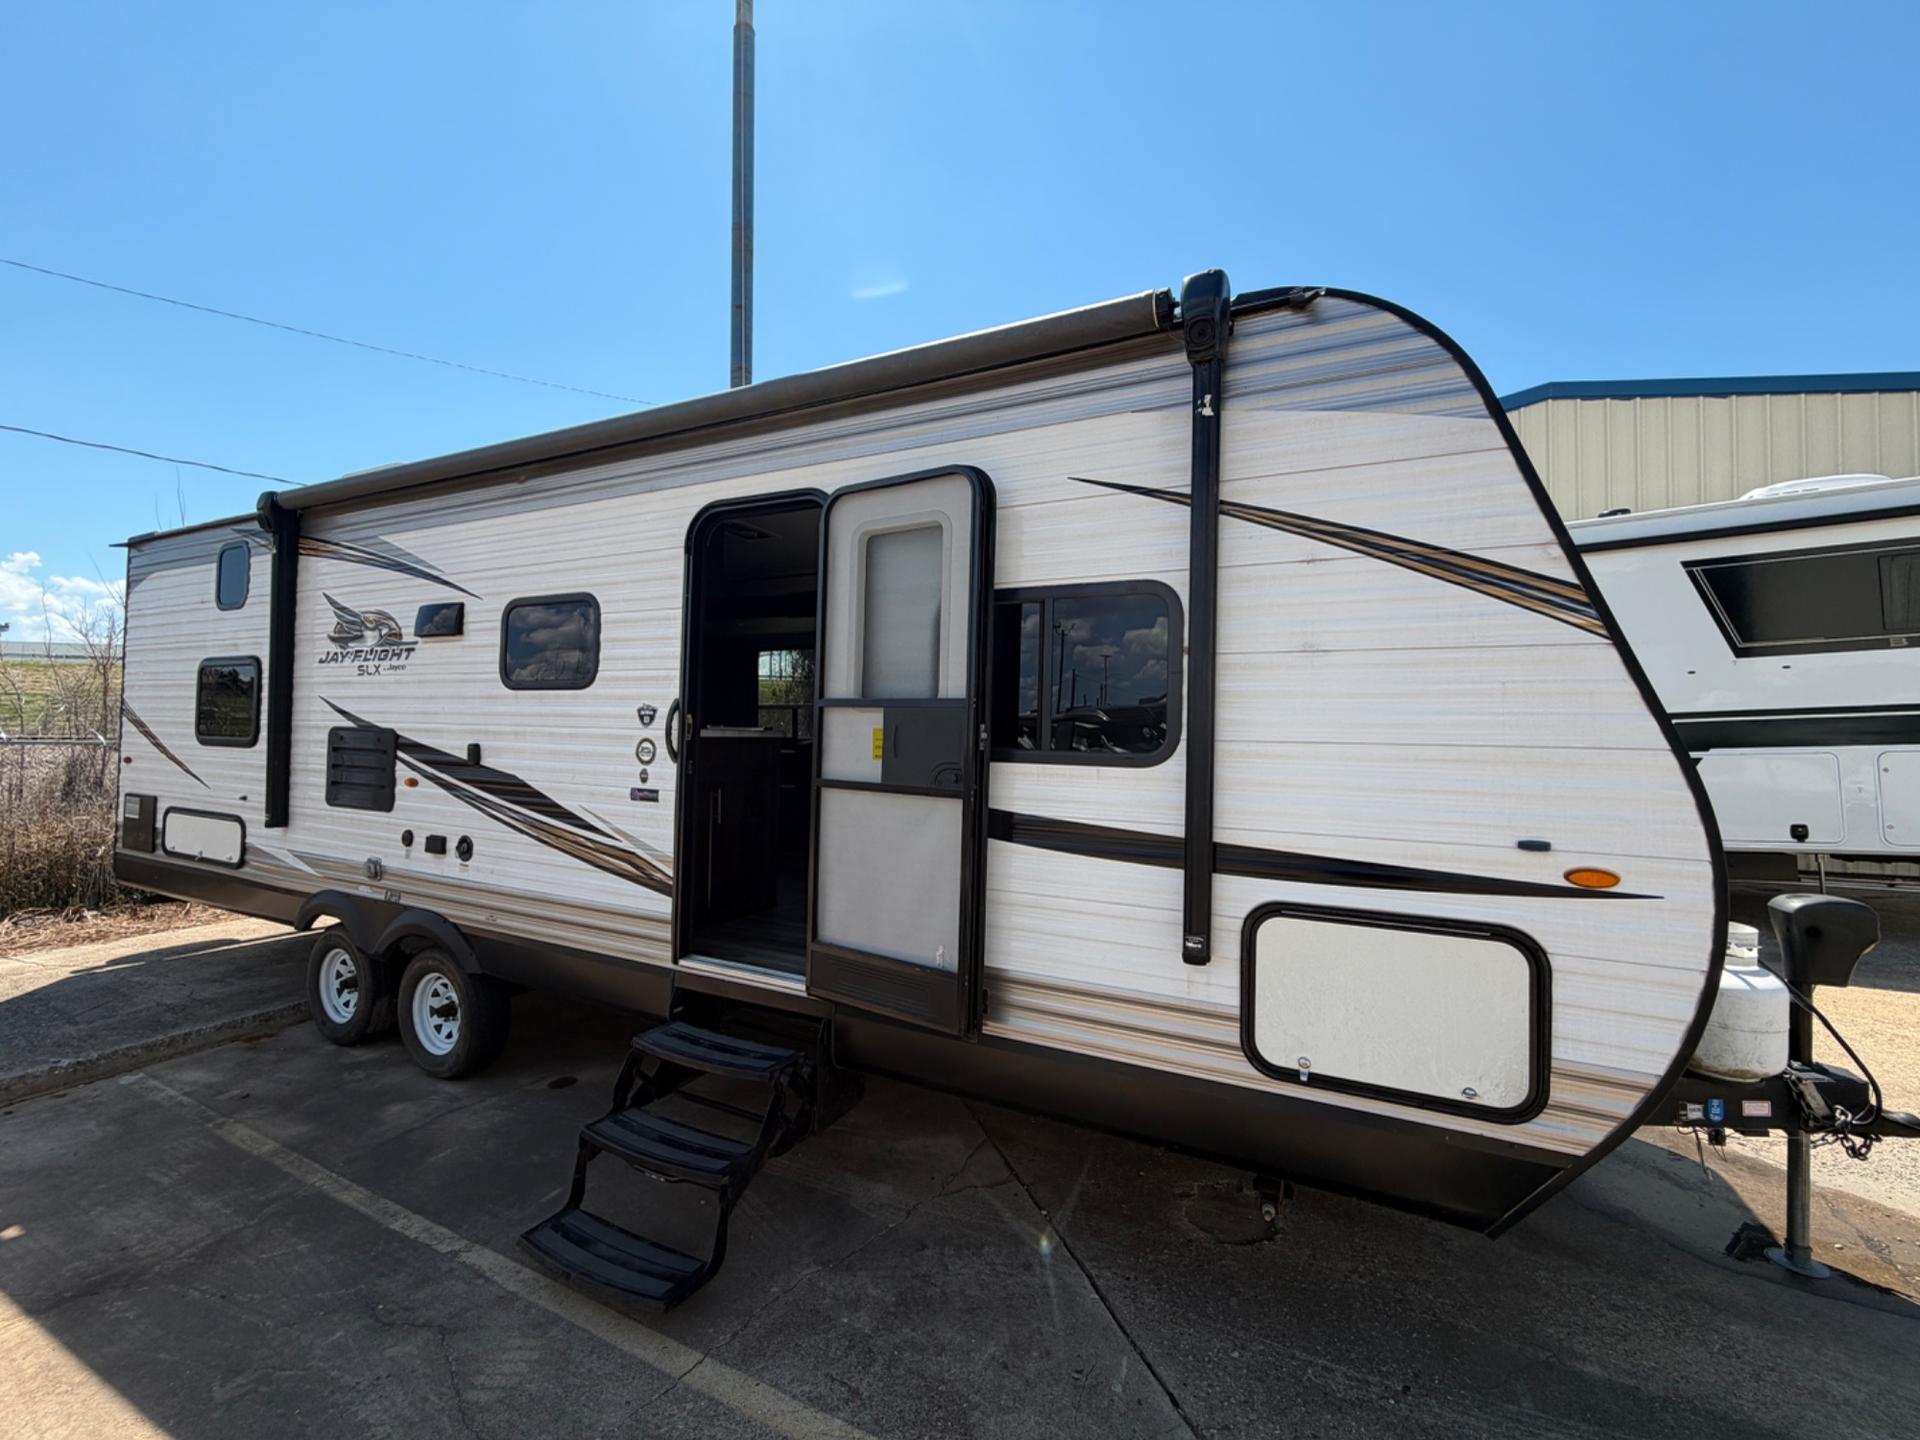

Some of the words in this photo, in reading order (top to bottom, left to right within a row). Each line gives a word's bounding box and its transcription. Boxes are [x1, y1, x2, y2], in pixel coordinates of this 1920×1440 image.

[318, 651, 349, 664] JAY
[351, 647, 415, 663] FLIGHT
[357, 664, 381, 676] SLX
